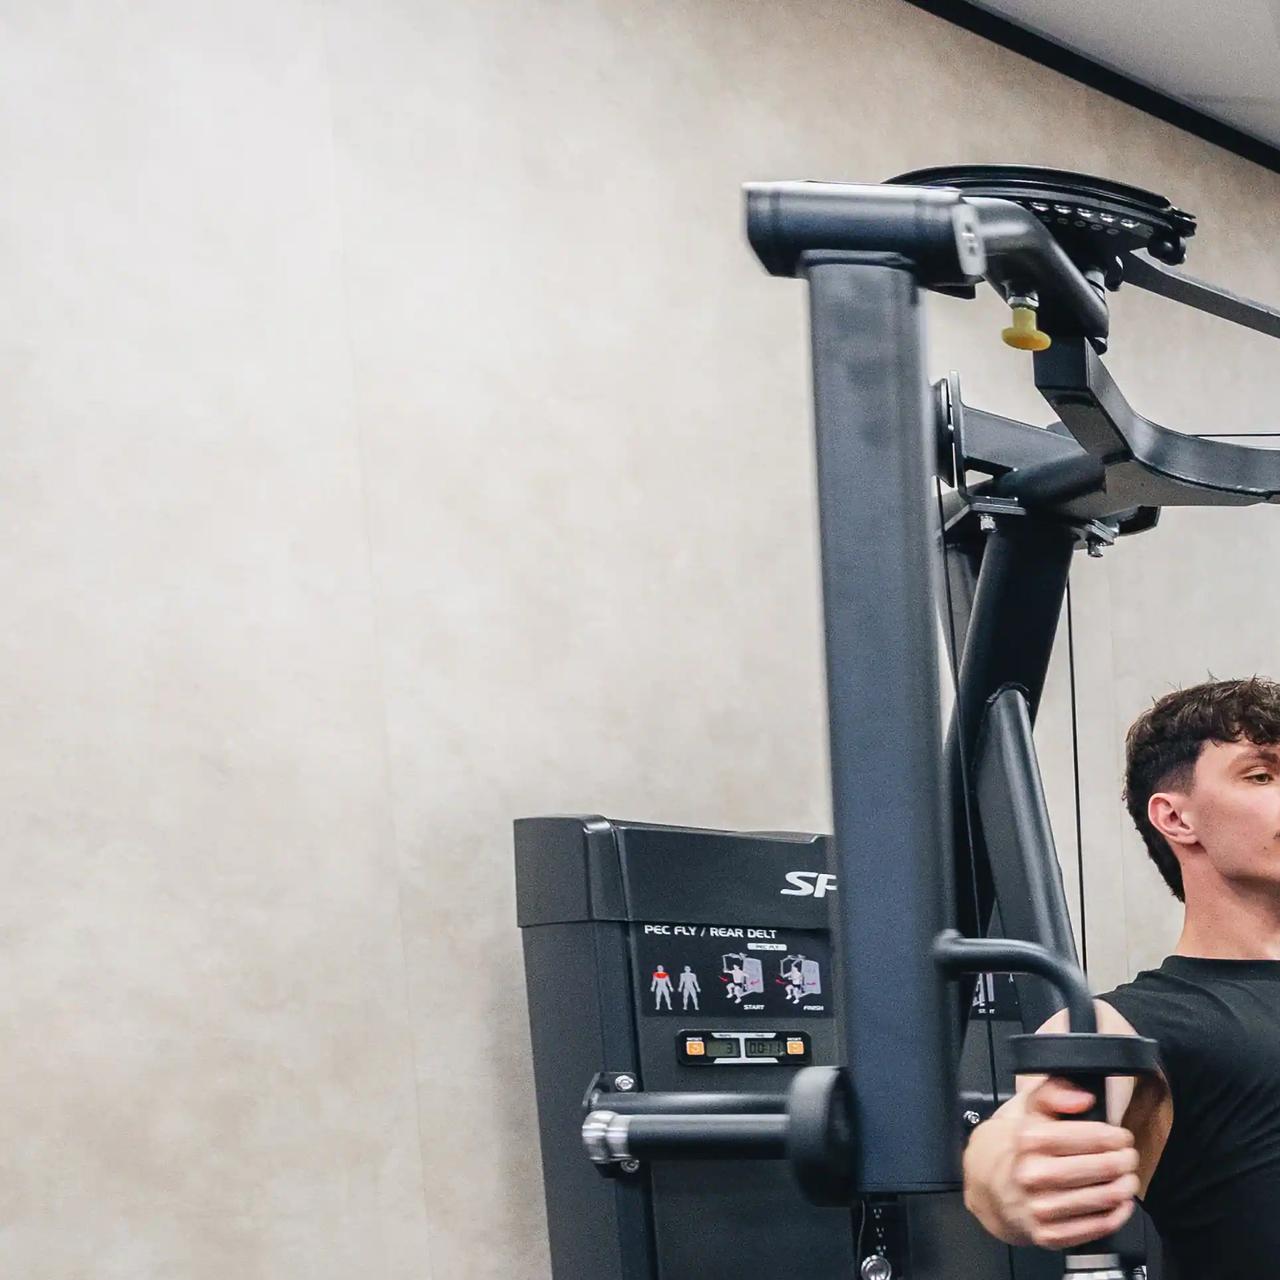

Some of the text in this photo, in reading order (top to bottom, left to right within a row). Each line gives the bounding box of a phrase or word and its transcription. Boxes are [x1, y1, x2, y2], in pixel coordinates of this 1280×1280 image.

[644, 924, 777, 939] PEC FLY / REAR DELT
